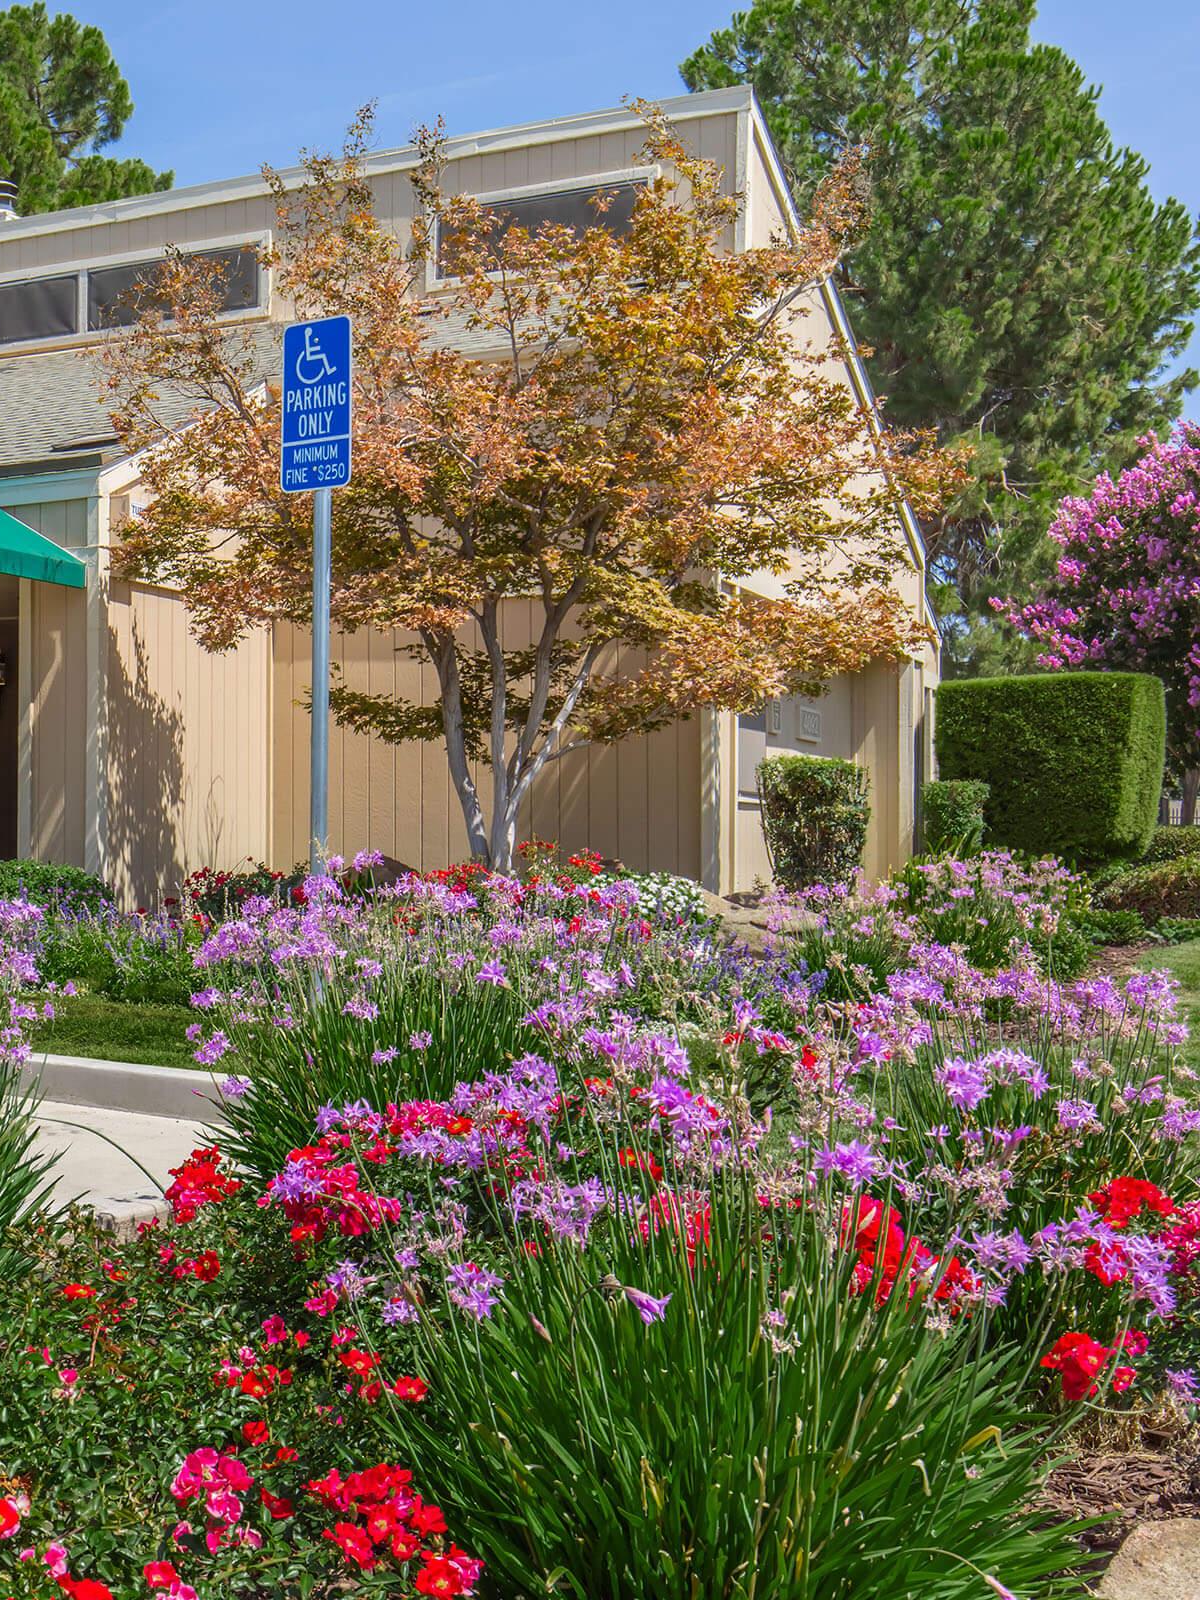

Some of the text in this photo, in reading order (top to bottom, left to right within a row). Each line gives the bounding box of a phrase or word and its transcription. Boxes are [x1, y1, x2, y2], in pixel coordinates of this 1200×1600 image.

[287, 382, 347, 413] PARKING
[298, 410, 334, 437] ONLY
[293, 444, 338, 464] MINIMUM
[286, 462, 345, 485] FINE $250
